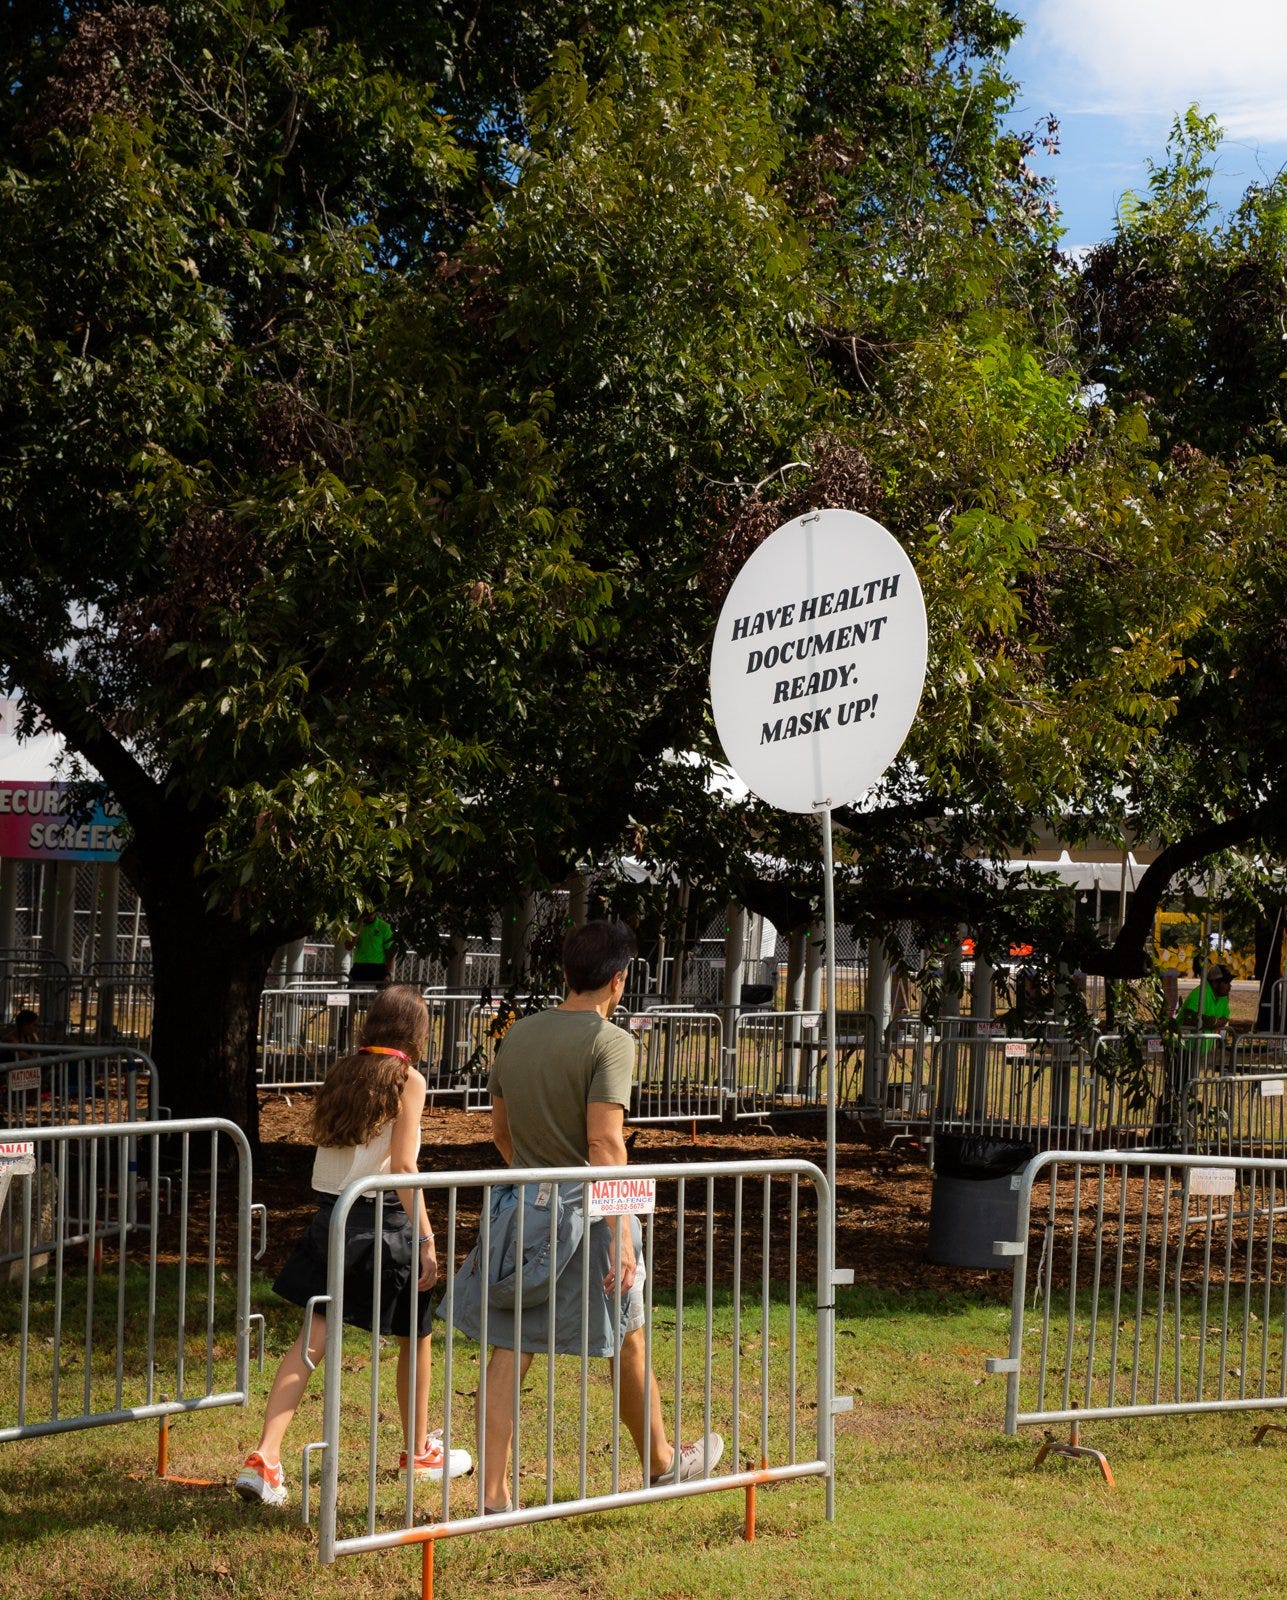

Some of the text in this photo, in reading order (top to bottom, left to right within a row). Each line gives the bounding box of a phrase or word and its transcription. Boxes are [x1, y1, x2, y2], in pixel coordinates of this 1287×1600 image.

[731, 574, 901, 641] HAVE HEALTH
[746, 617, 888, 674] DOCUMENT
[772, 663, 859, 704] READY.
[760, 693, 879, 745] MASK UP!
[592, 1180, 653, 1198] NATIONAL
